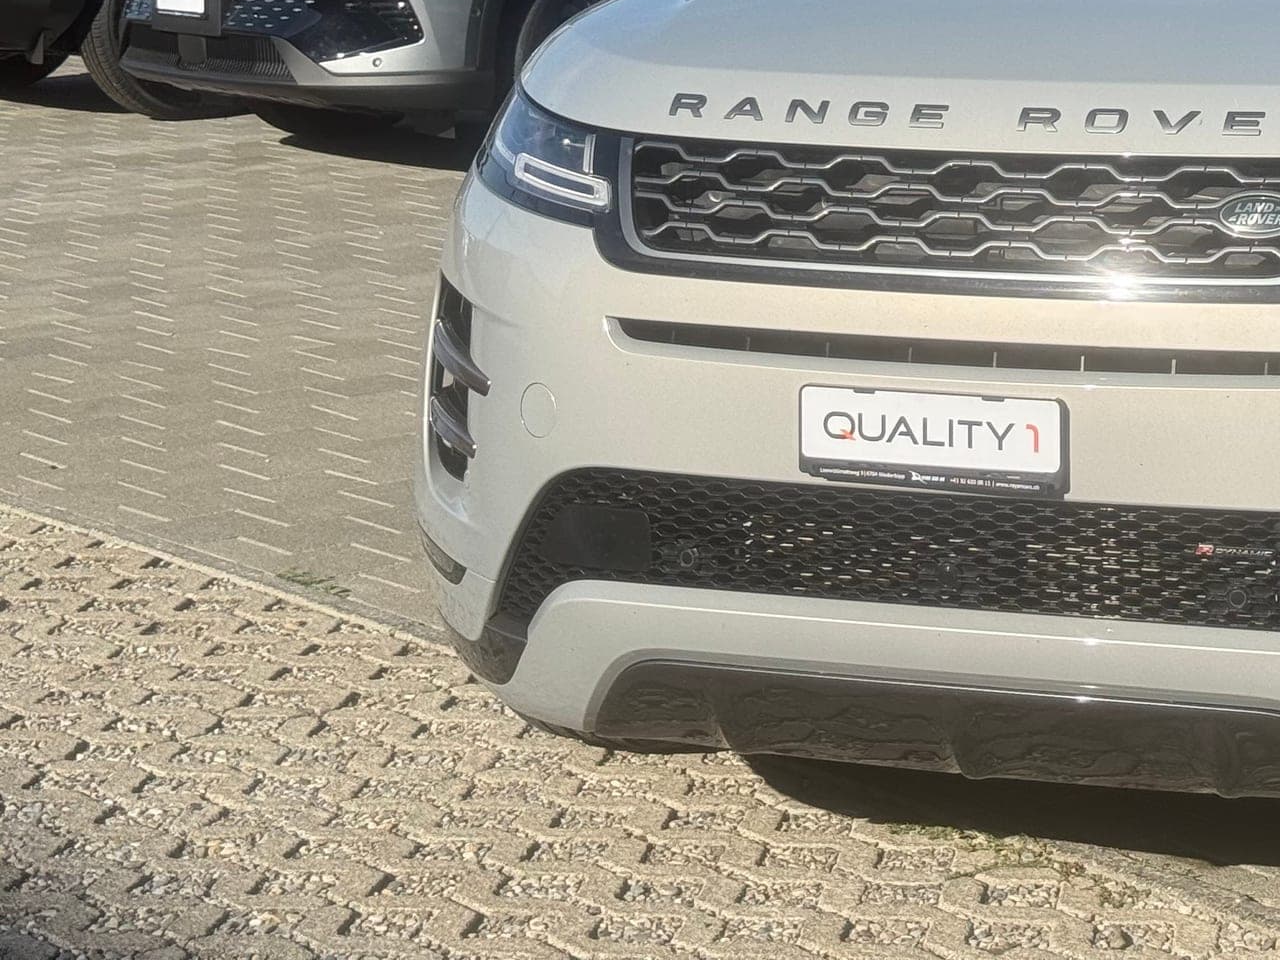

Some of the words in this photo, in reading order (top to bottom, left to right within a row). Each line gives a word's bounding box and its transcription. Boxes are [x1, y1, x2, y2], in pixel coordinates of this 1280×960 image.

[669, 93, 950, 129] RANGE
[1234, 202, 1275, 213] LAND
[823, 411, 1015, 451] QUALITY
[1025, 423, 1039, 453] 1
